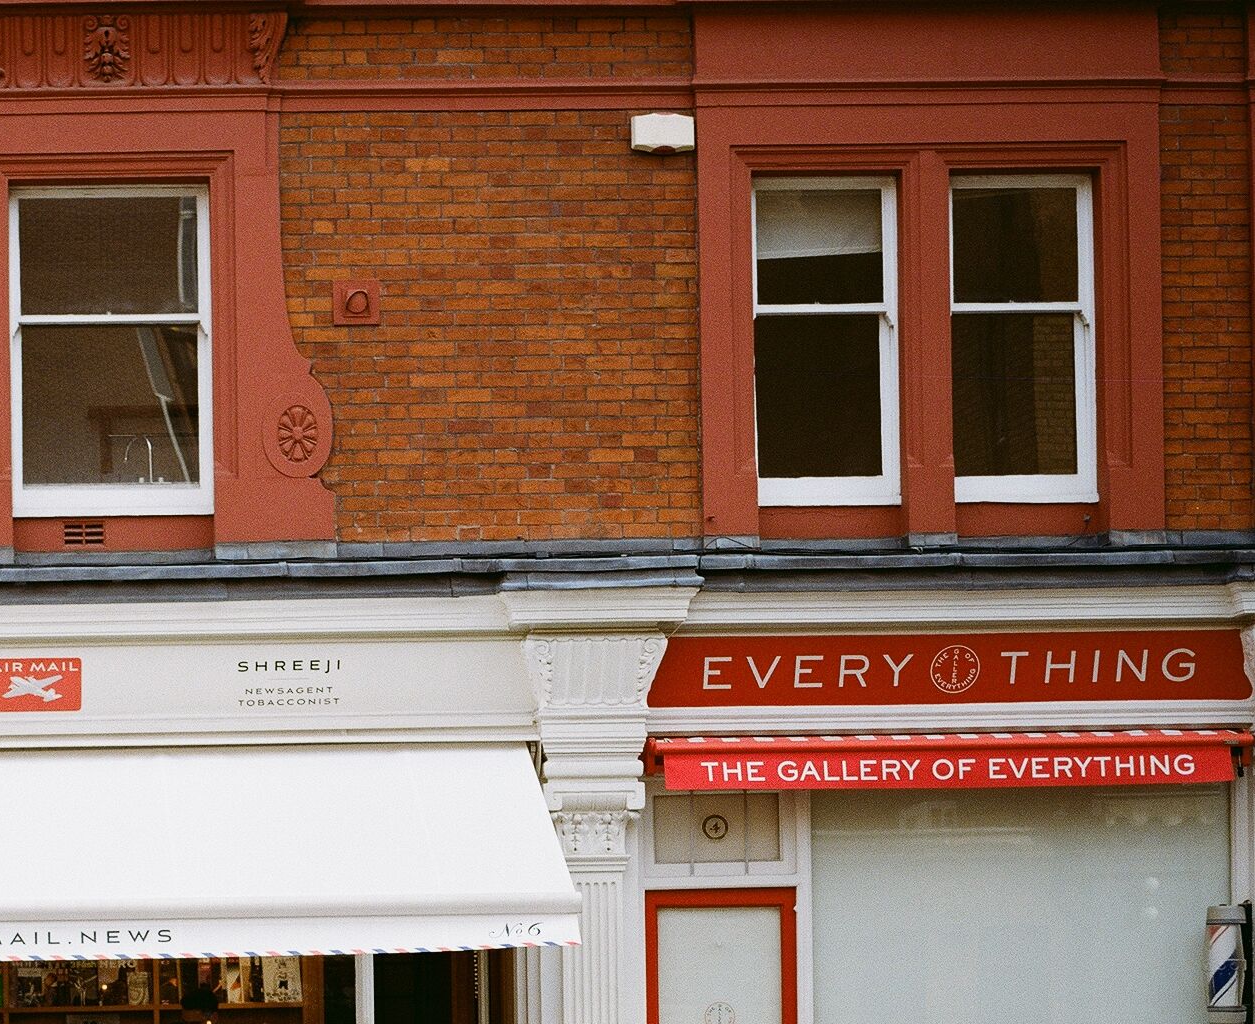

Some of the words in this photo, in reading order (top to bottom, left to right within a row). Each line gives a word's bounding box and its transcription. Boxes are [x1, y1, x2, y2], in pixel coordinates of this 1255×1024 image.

[935, 652, 949, 667] THE
[965, 653, 975, 663] OF
[30, 661, 79, 672] MAIL
[238, 659, 341, 674] SHREEJI
[702, 654, 914, 690] EVERY
[1000, 648, 1196, 684] THING
[935, 668, 976, 690] EVERYTHING
[244, 686, 334, 695] NEWSAGENT
[238, 698, 340, 707] TOBACCONIST
[701, 761, 766, 782] THE
[776, 758, 922, 783] GALLERY
[931, 758, 972, 780] OF
[988, 754, 1196, 780] EVERYTHING
[528, 921, 544, 936] 6
